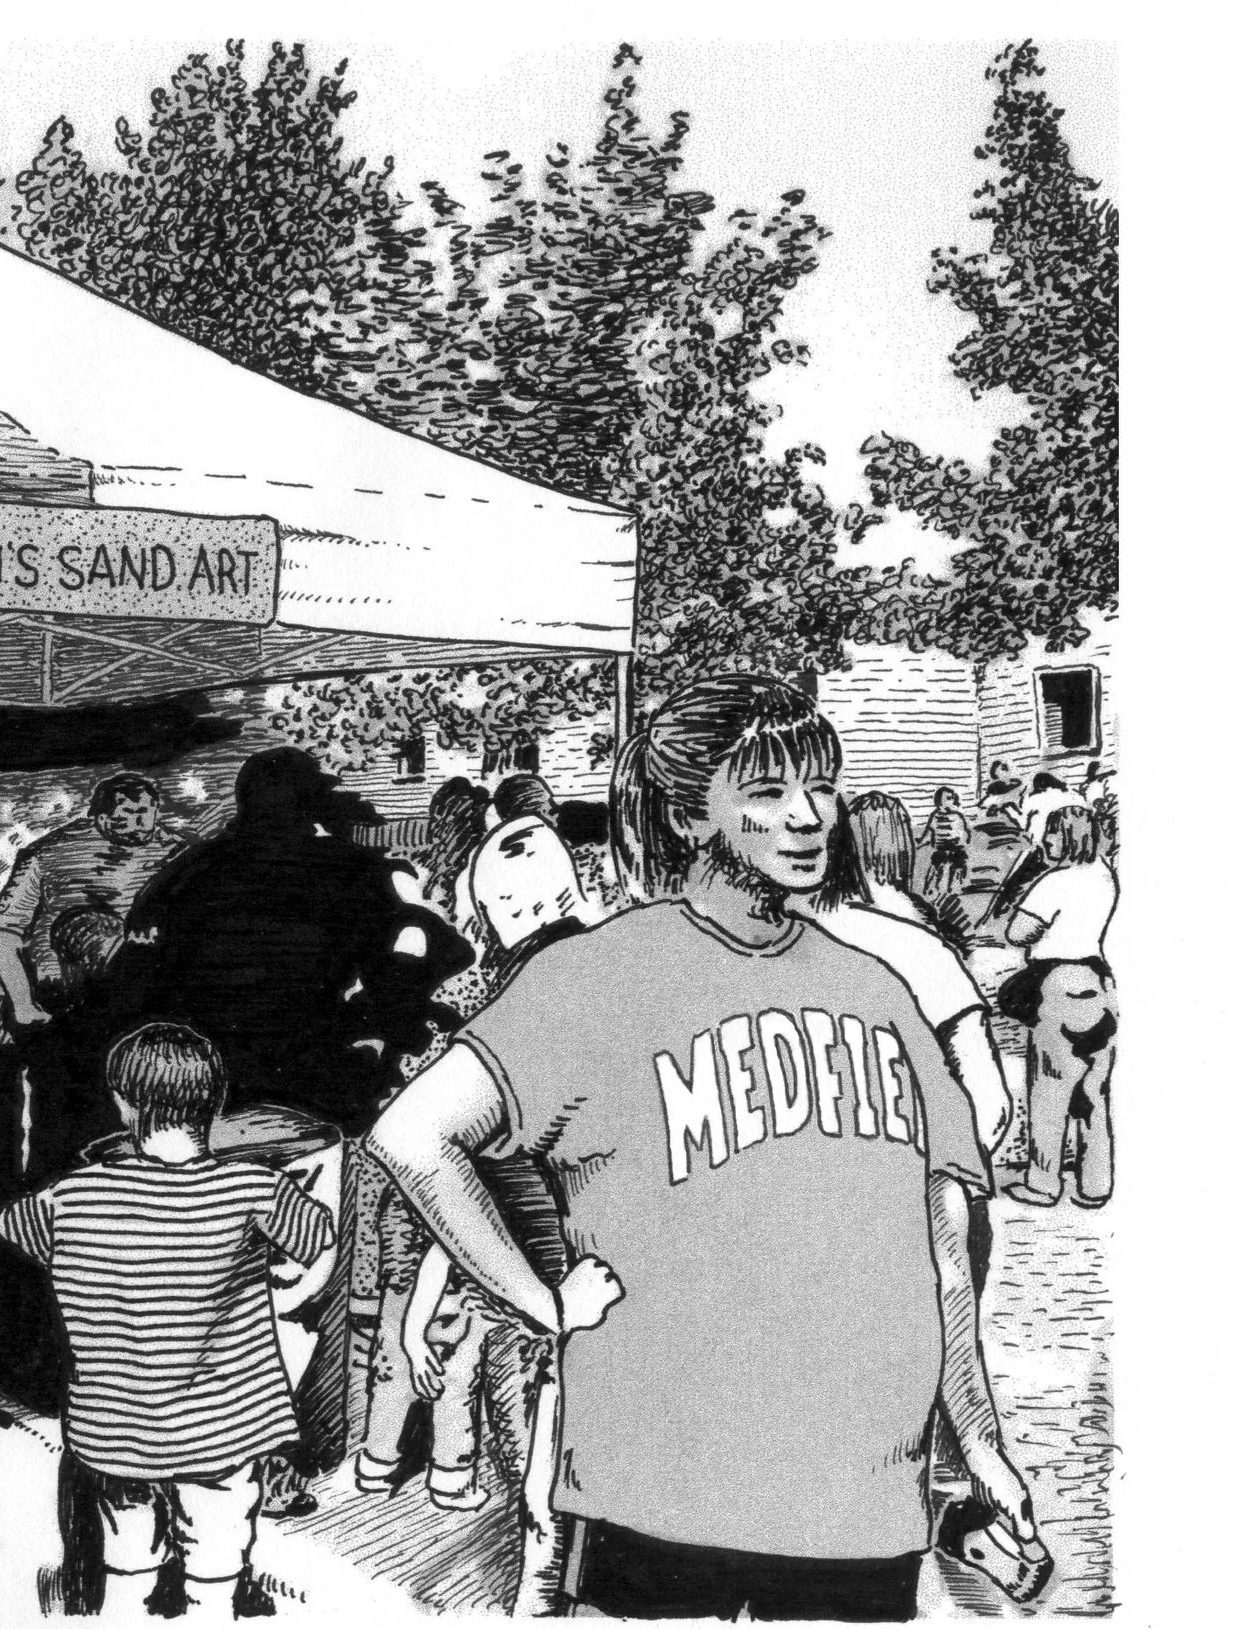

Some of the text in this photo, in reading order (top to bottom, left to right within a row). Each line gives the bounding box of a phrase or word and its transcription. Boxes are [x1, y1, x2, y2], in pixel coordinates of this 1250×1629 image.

[57, 543, 177, 591] SAND
[188, 544, 259, 596] ART
[652, 1007, 927, 1186] MEDFIE
